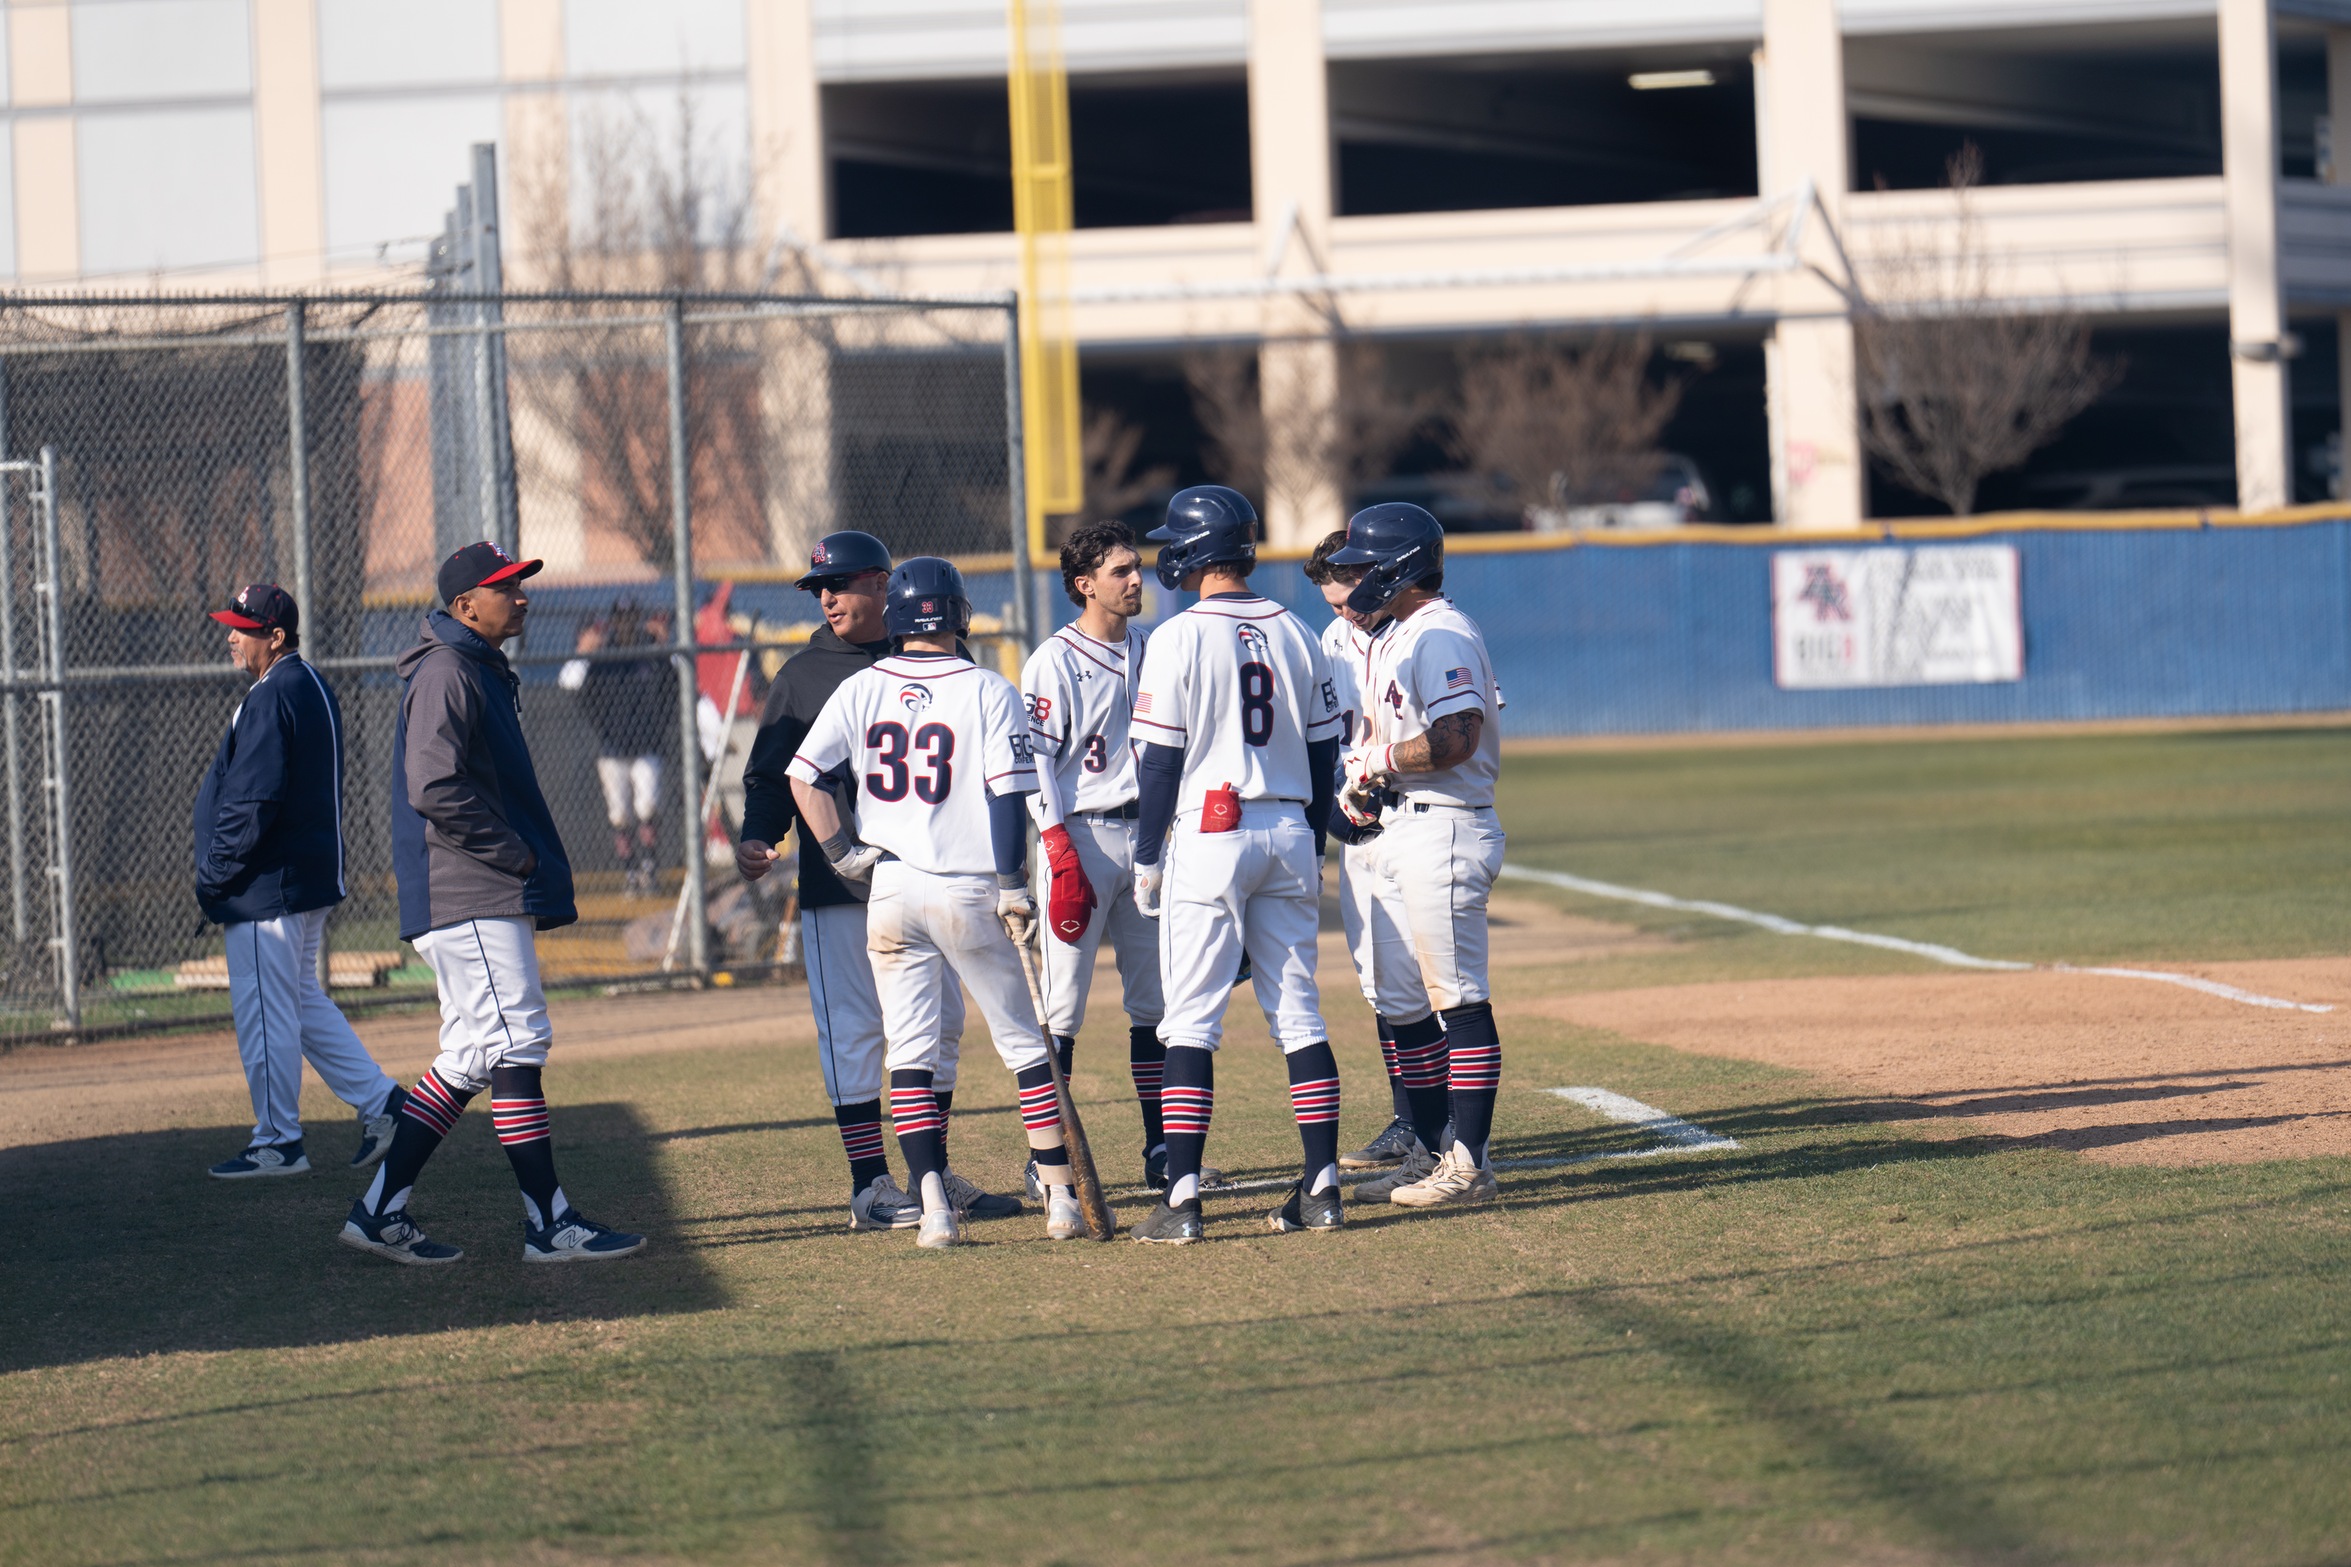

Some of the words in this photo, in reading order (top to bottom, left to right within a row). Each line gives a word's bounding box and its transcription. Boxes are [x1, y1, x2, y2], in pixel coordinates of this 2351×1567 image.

[921, 601, 934, 613] 33
[1240, 661, 1274, 747] 8
[866, 721, 955, 805] 33
[1084, 734, 1107, 774] 3
